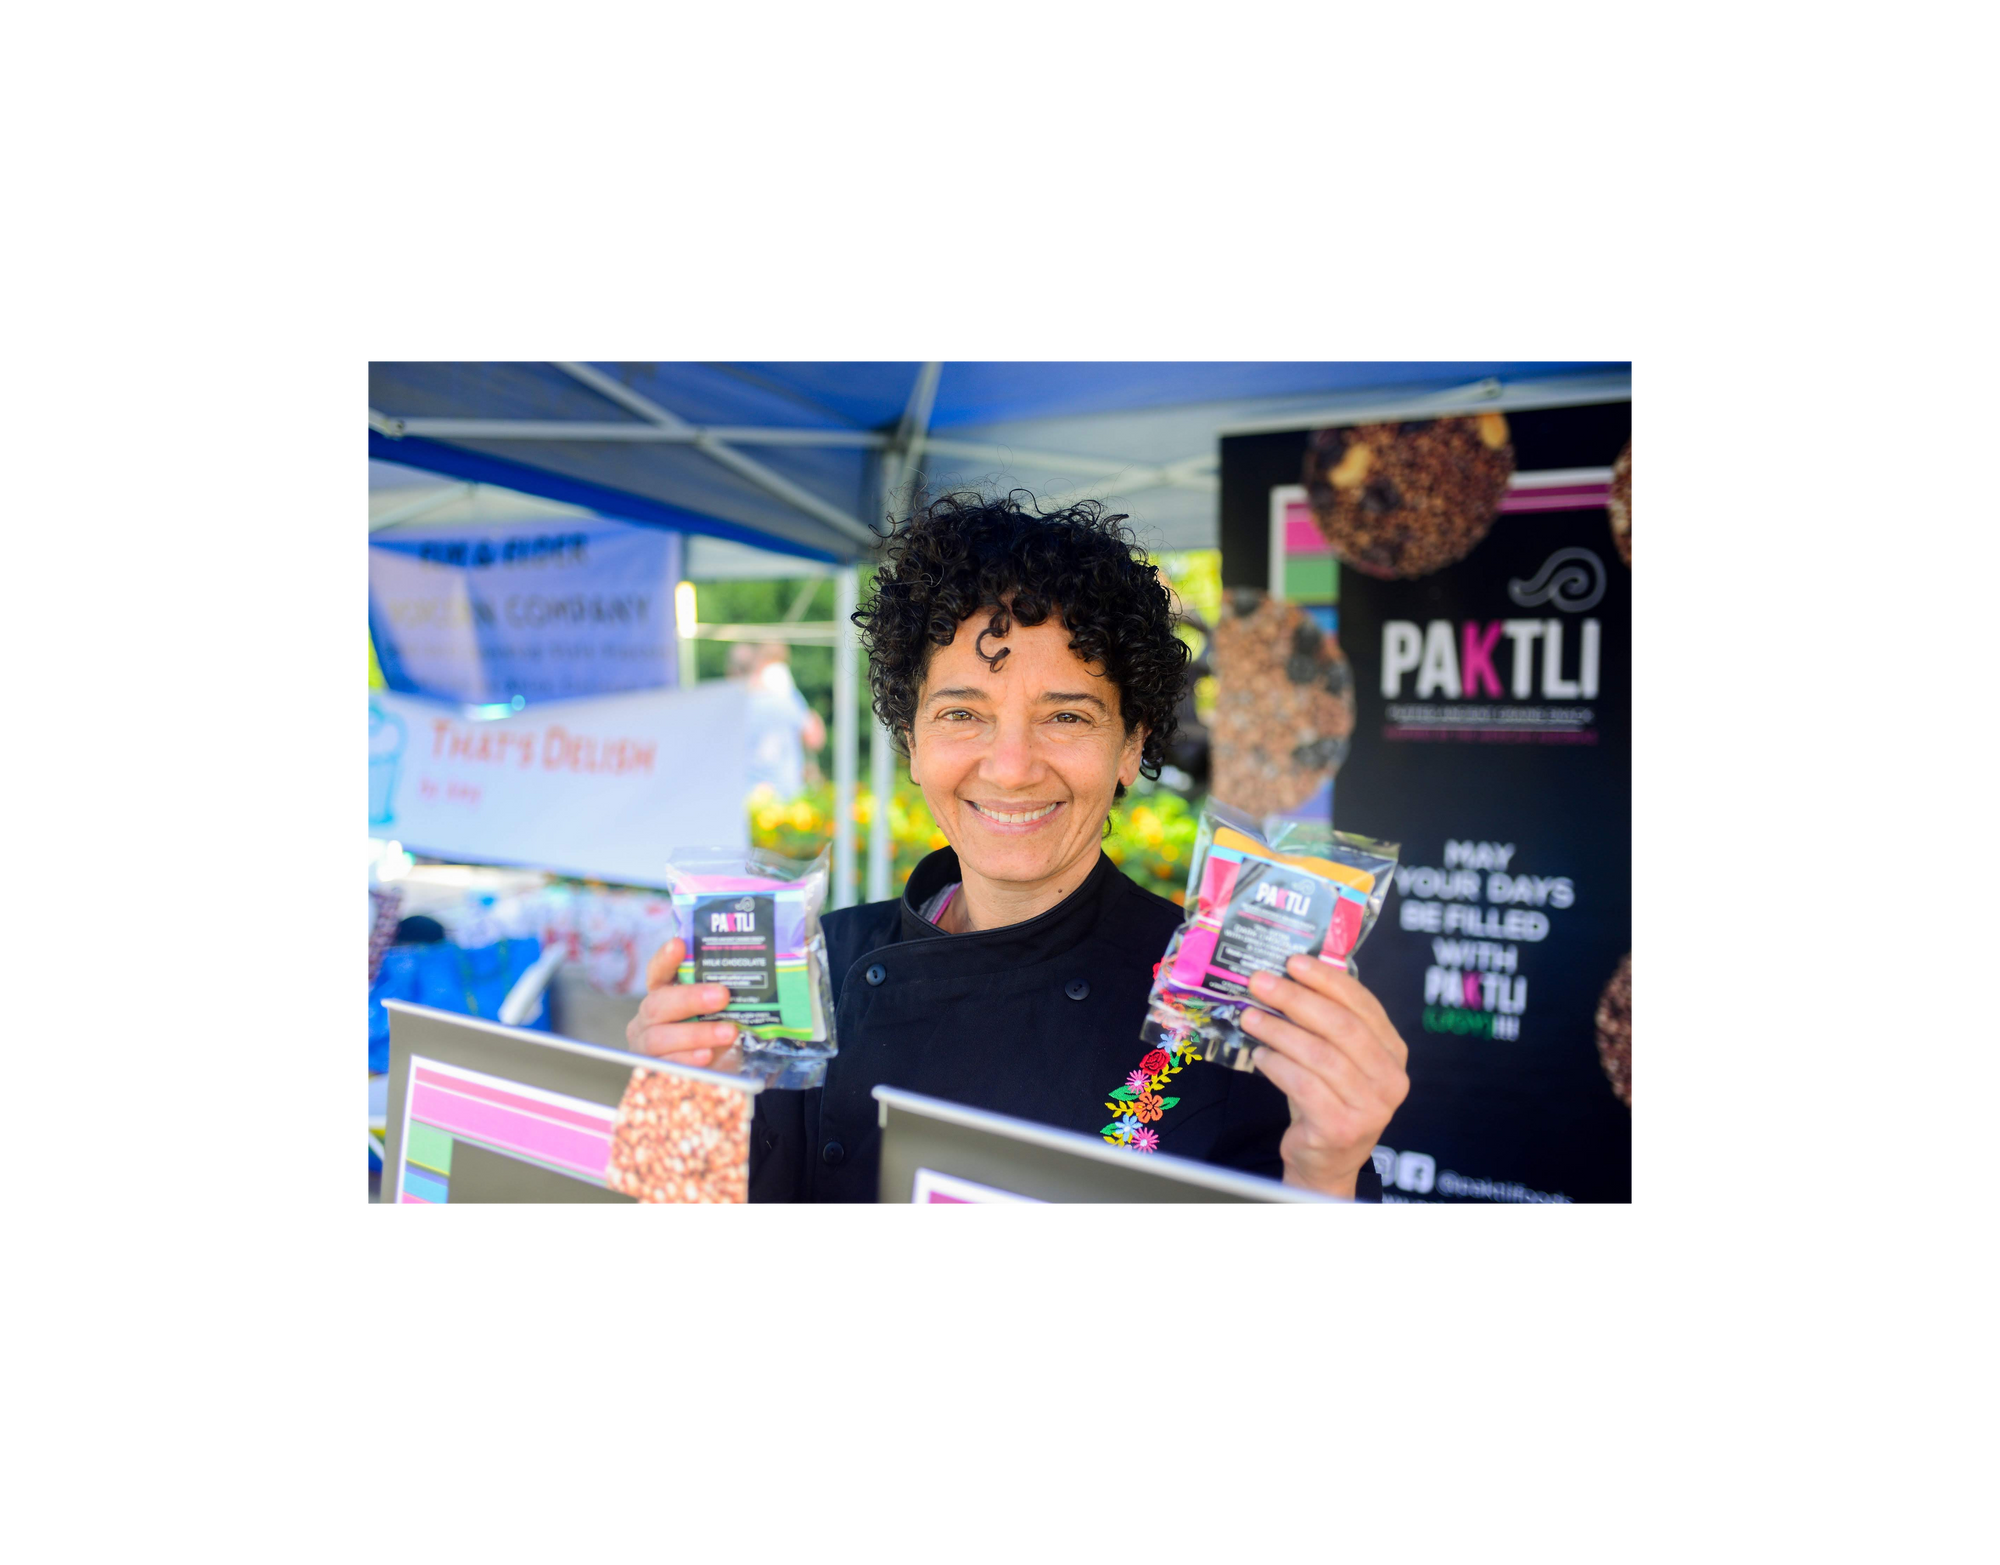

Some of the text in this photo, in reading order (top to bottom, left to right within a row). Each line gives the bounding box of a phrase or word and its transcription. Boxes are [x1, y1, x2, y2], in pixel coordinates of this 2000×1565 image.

[504, 591, 652, 628] COMPANY
[1381, 618, 1601, 700] PAKTLI
[430, 718, 658, 776] THAT'S DELISH
[1444, 839, 1515, 872] MAY
[1255, 882, 1311, 917] PAKTLI
[1395, 866, 1575, 909] YOUR DAYS
[711, 912, 755, 932] PAKTLI
[1400, 899, 1550, 942] BE FILLED
[702, 957, 767, 967] MILK CHOCOLATE
[1432, 936, 1518, 974] WITH
[1424, 966, 1528, 1015] PAKTLI
